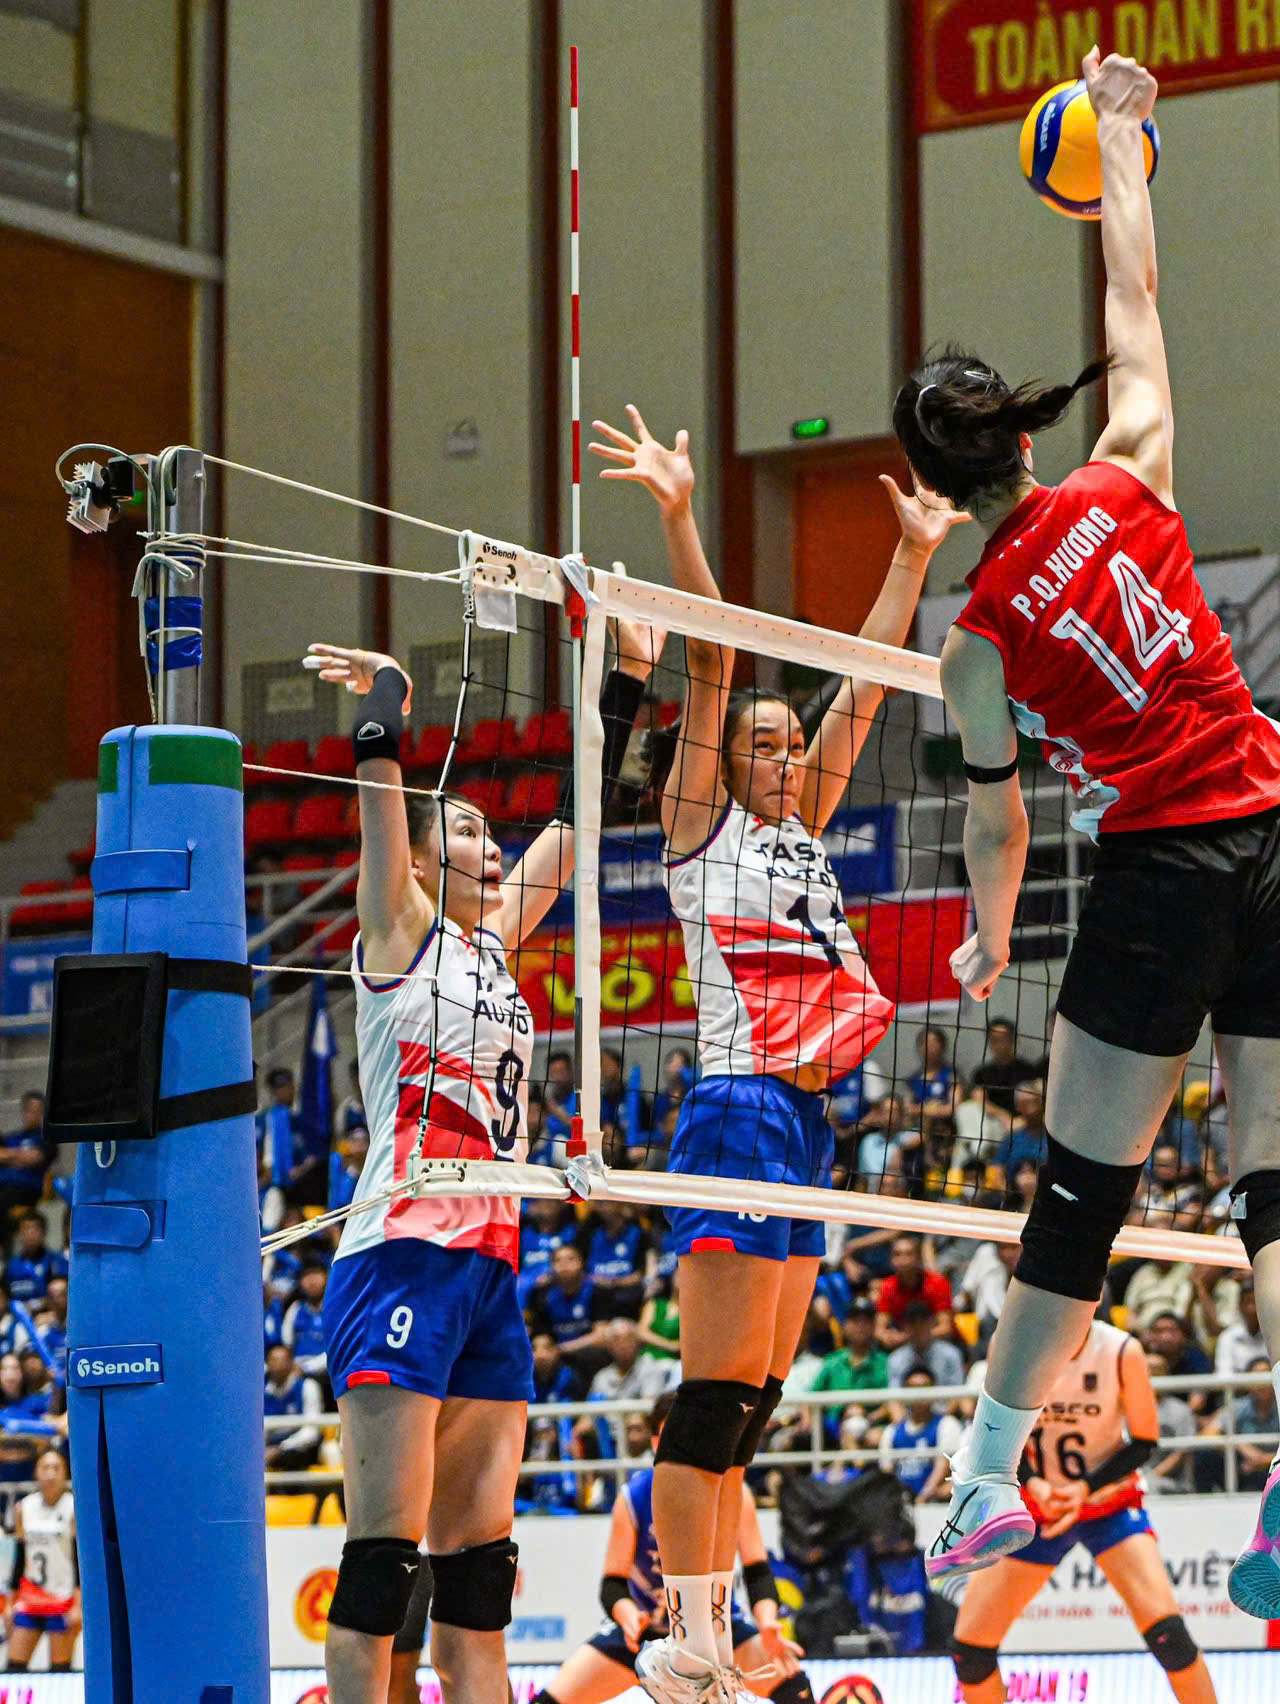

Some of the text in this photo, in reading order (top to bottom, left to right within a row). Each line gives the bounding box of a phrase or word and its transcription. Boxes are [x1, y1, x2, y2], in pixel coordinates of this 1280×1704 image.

[491, 545, 517, 560] Senoh
[1010, 506, 1119, 623] P.Q.HƯƠNG
[1049, 550, 1195, 713] 14
[491, 1049, 524, 1152] 9
[386, 1306, 414, 1349] 9
[92, 1358, 160, 1376] Senoh
[1030, 1427, 1086, 1480] 16
